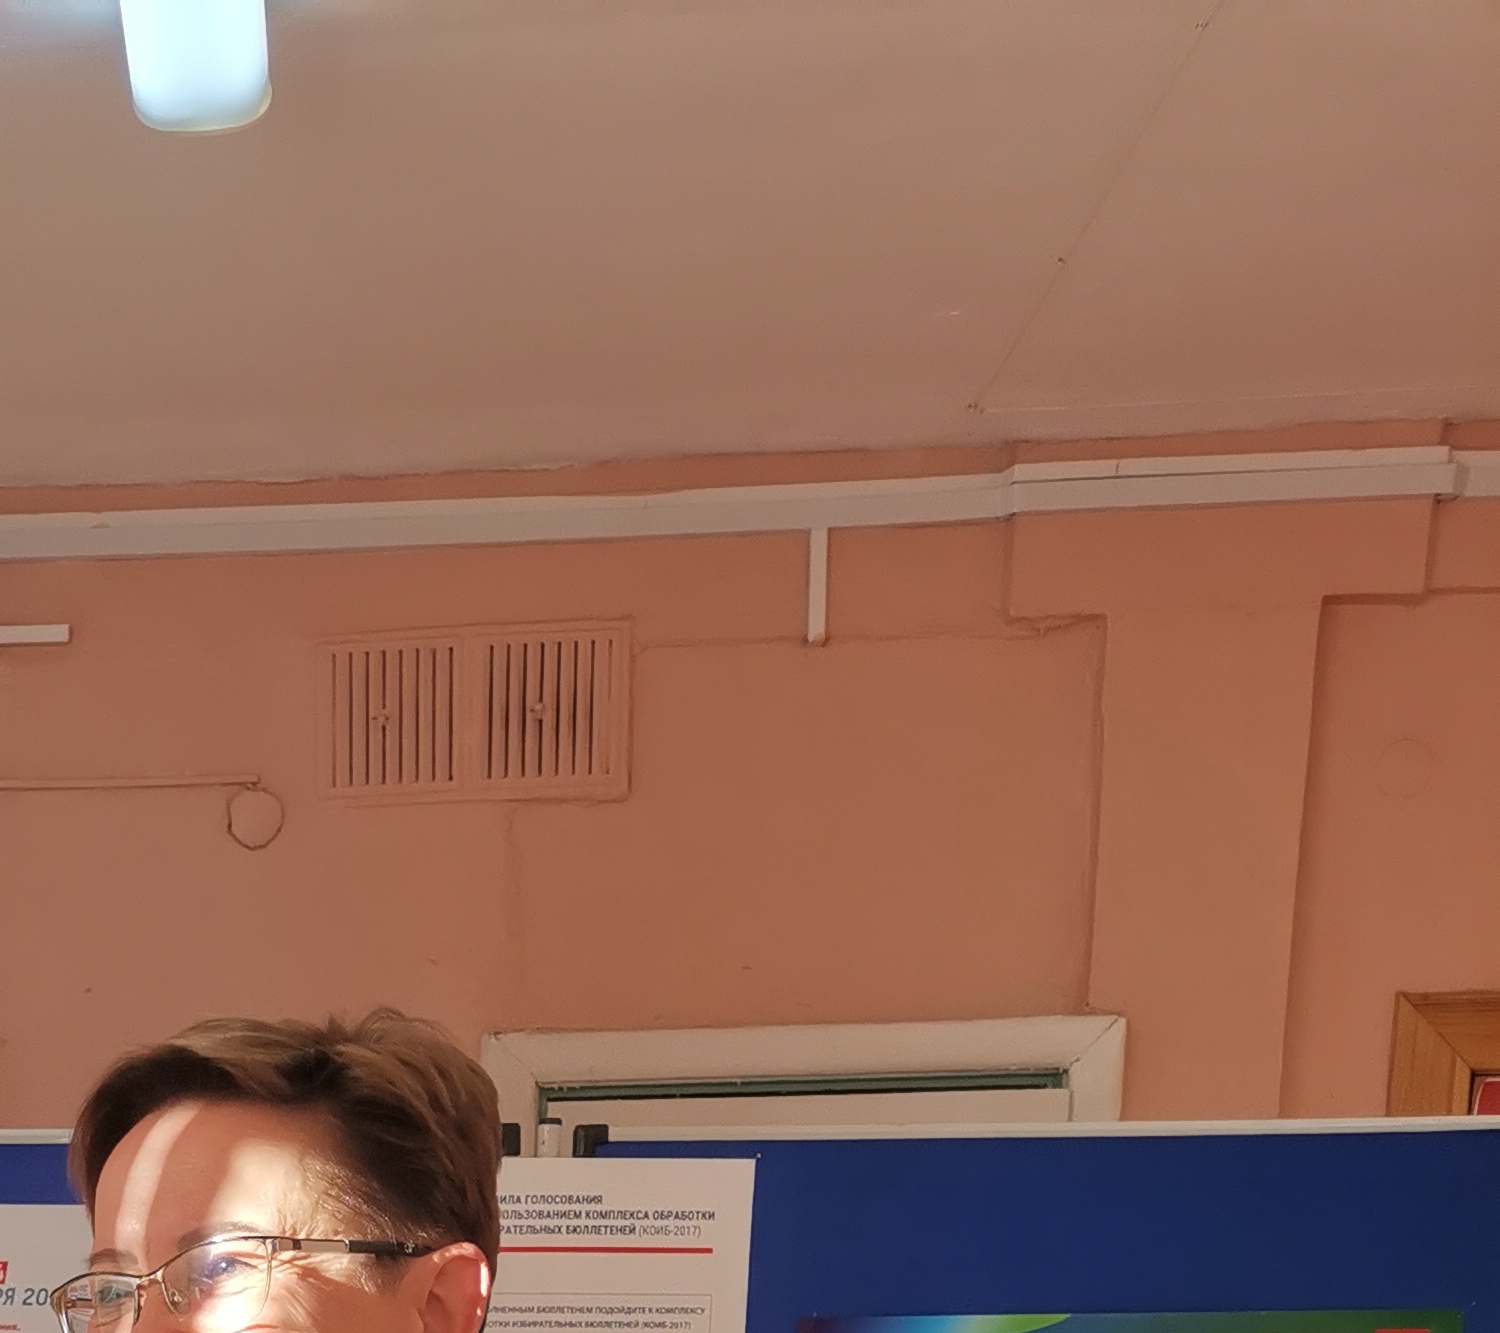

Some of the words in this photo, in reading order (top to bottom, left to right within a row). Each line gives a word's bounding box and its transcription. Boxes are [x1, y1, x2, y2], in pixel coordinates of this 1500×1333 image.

[497, 1194, 522, 1205] ИЛА
[524, 1194, 603, 1206] ГОЛОСОВАНИЯ
[500, 1209, 582, 1221] ОЛЬЗОВАНИЕМ
[585, 1209, 650, 1222] КОМПЛЕКСА
[652, 1210, 715, 1222] ОБРАБОТКИ
[565, 1221, 637, 1236] БЮЛЛЕТЕНЕЙ
[638, 1224, 702, 1238] (КОИБ-2017)
[21, 1287, 50, 1307] 20
